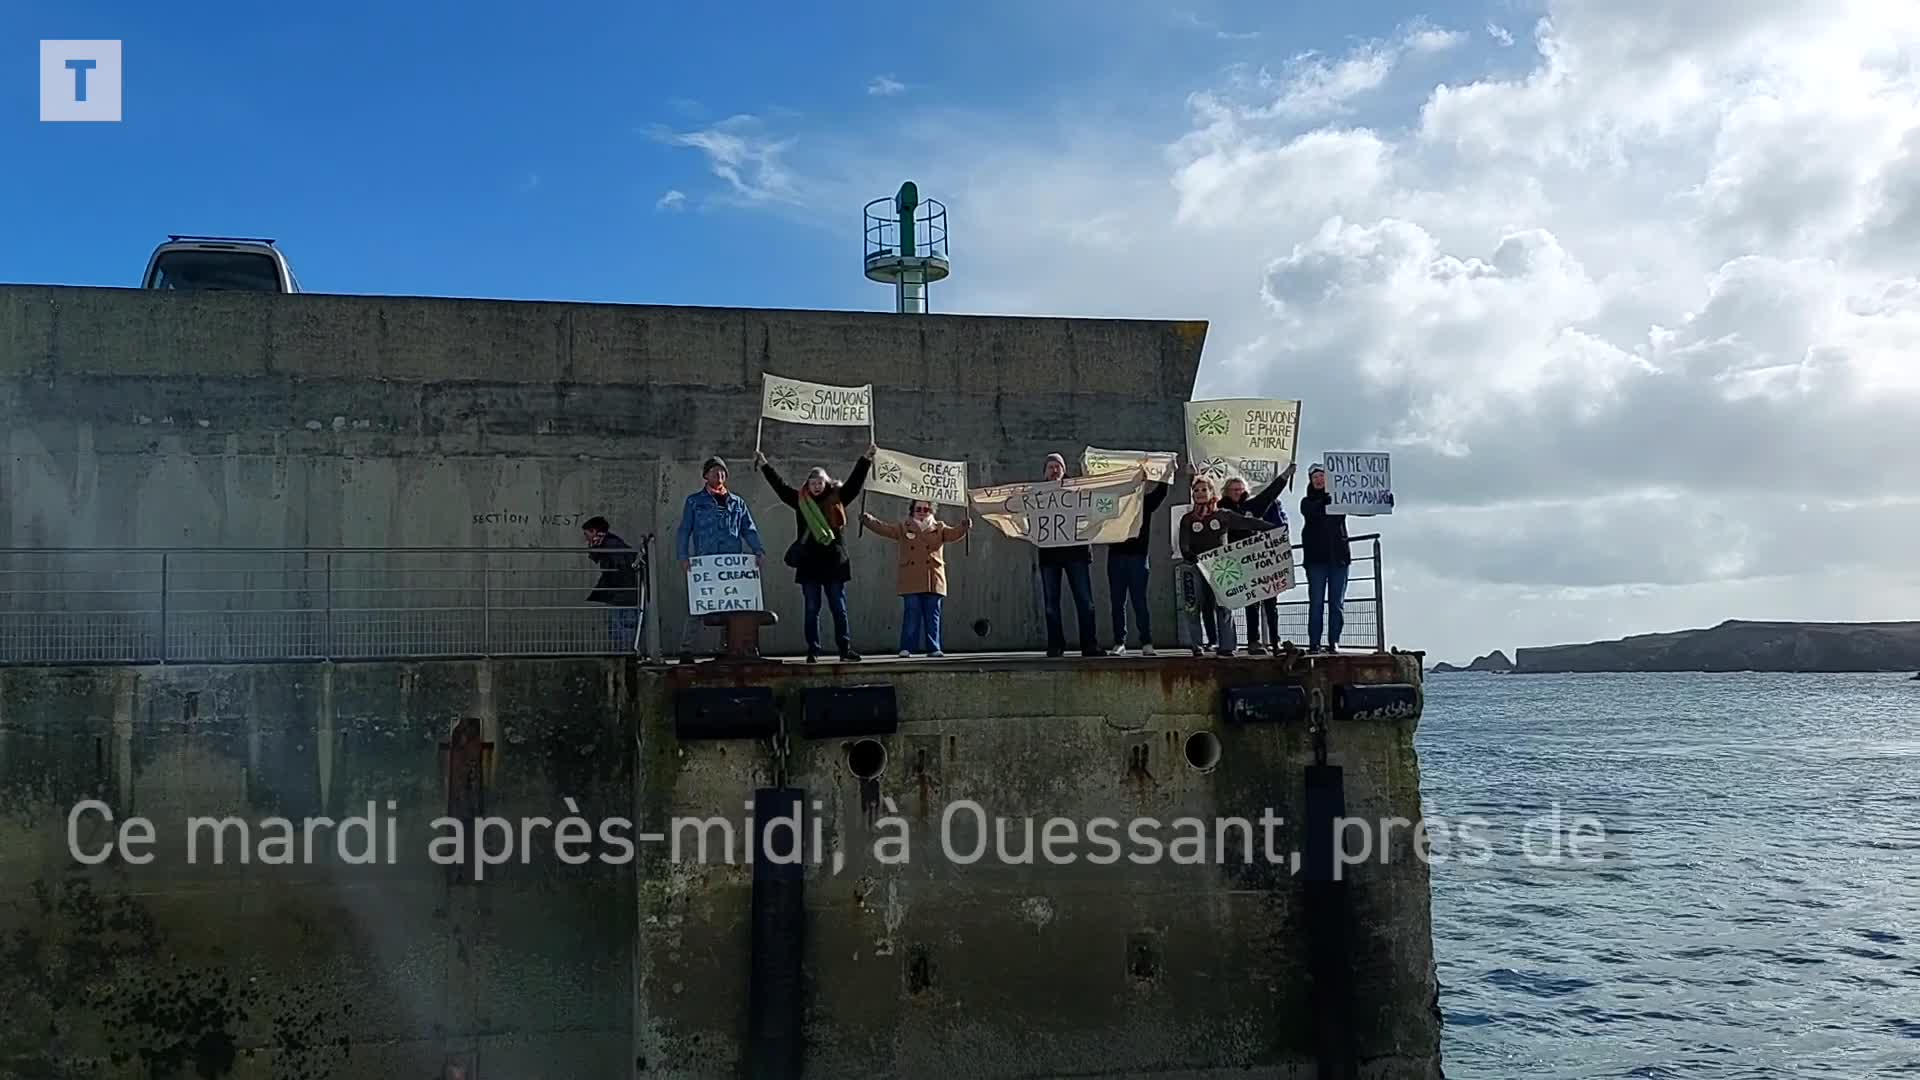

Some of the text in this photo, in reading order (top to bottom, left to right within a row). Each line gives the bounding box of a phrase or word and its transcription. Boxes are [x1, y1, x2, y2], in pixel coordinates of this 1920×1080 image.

[811, 389, 871, 406] SAUVONS
[1245, 410, 1296, 424] SAUVONS
[1245, 423, 1292, 437] LE PHARE
[1249, 437, 1288, 451] AMIRAL
[1327, 456, 1390, 473] ON NE VEUT
[1335, 474, 1357, 488] PAS
[911, 483, 959, 500] BATTANT
[541, 512, 584, 527] WEST
[1199, 549, 1219, 561] VIVE
[1223, 545, 1232, 553] LE
[714, 556, 749, 567] COUP
[1256, 560, 1273, 570] FOR
[693, 572, 712, 582] DE
[1226, 567, 1290, 597] GUIDE SAUVEUR
[701, 586, 738, 595] ET ÇA
[1245, 578, 1287, 600] DE VIES
